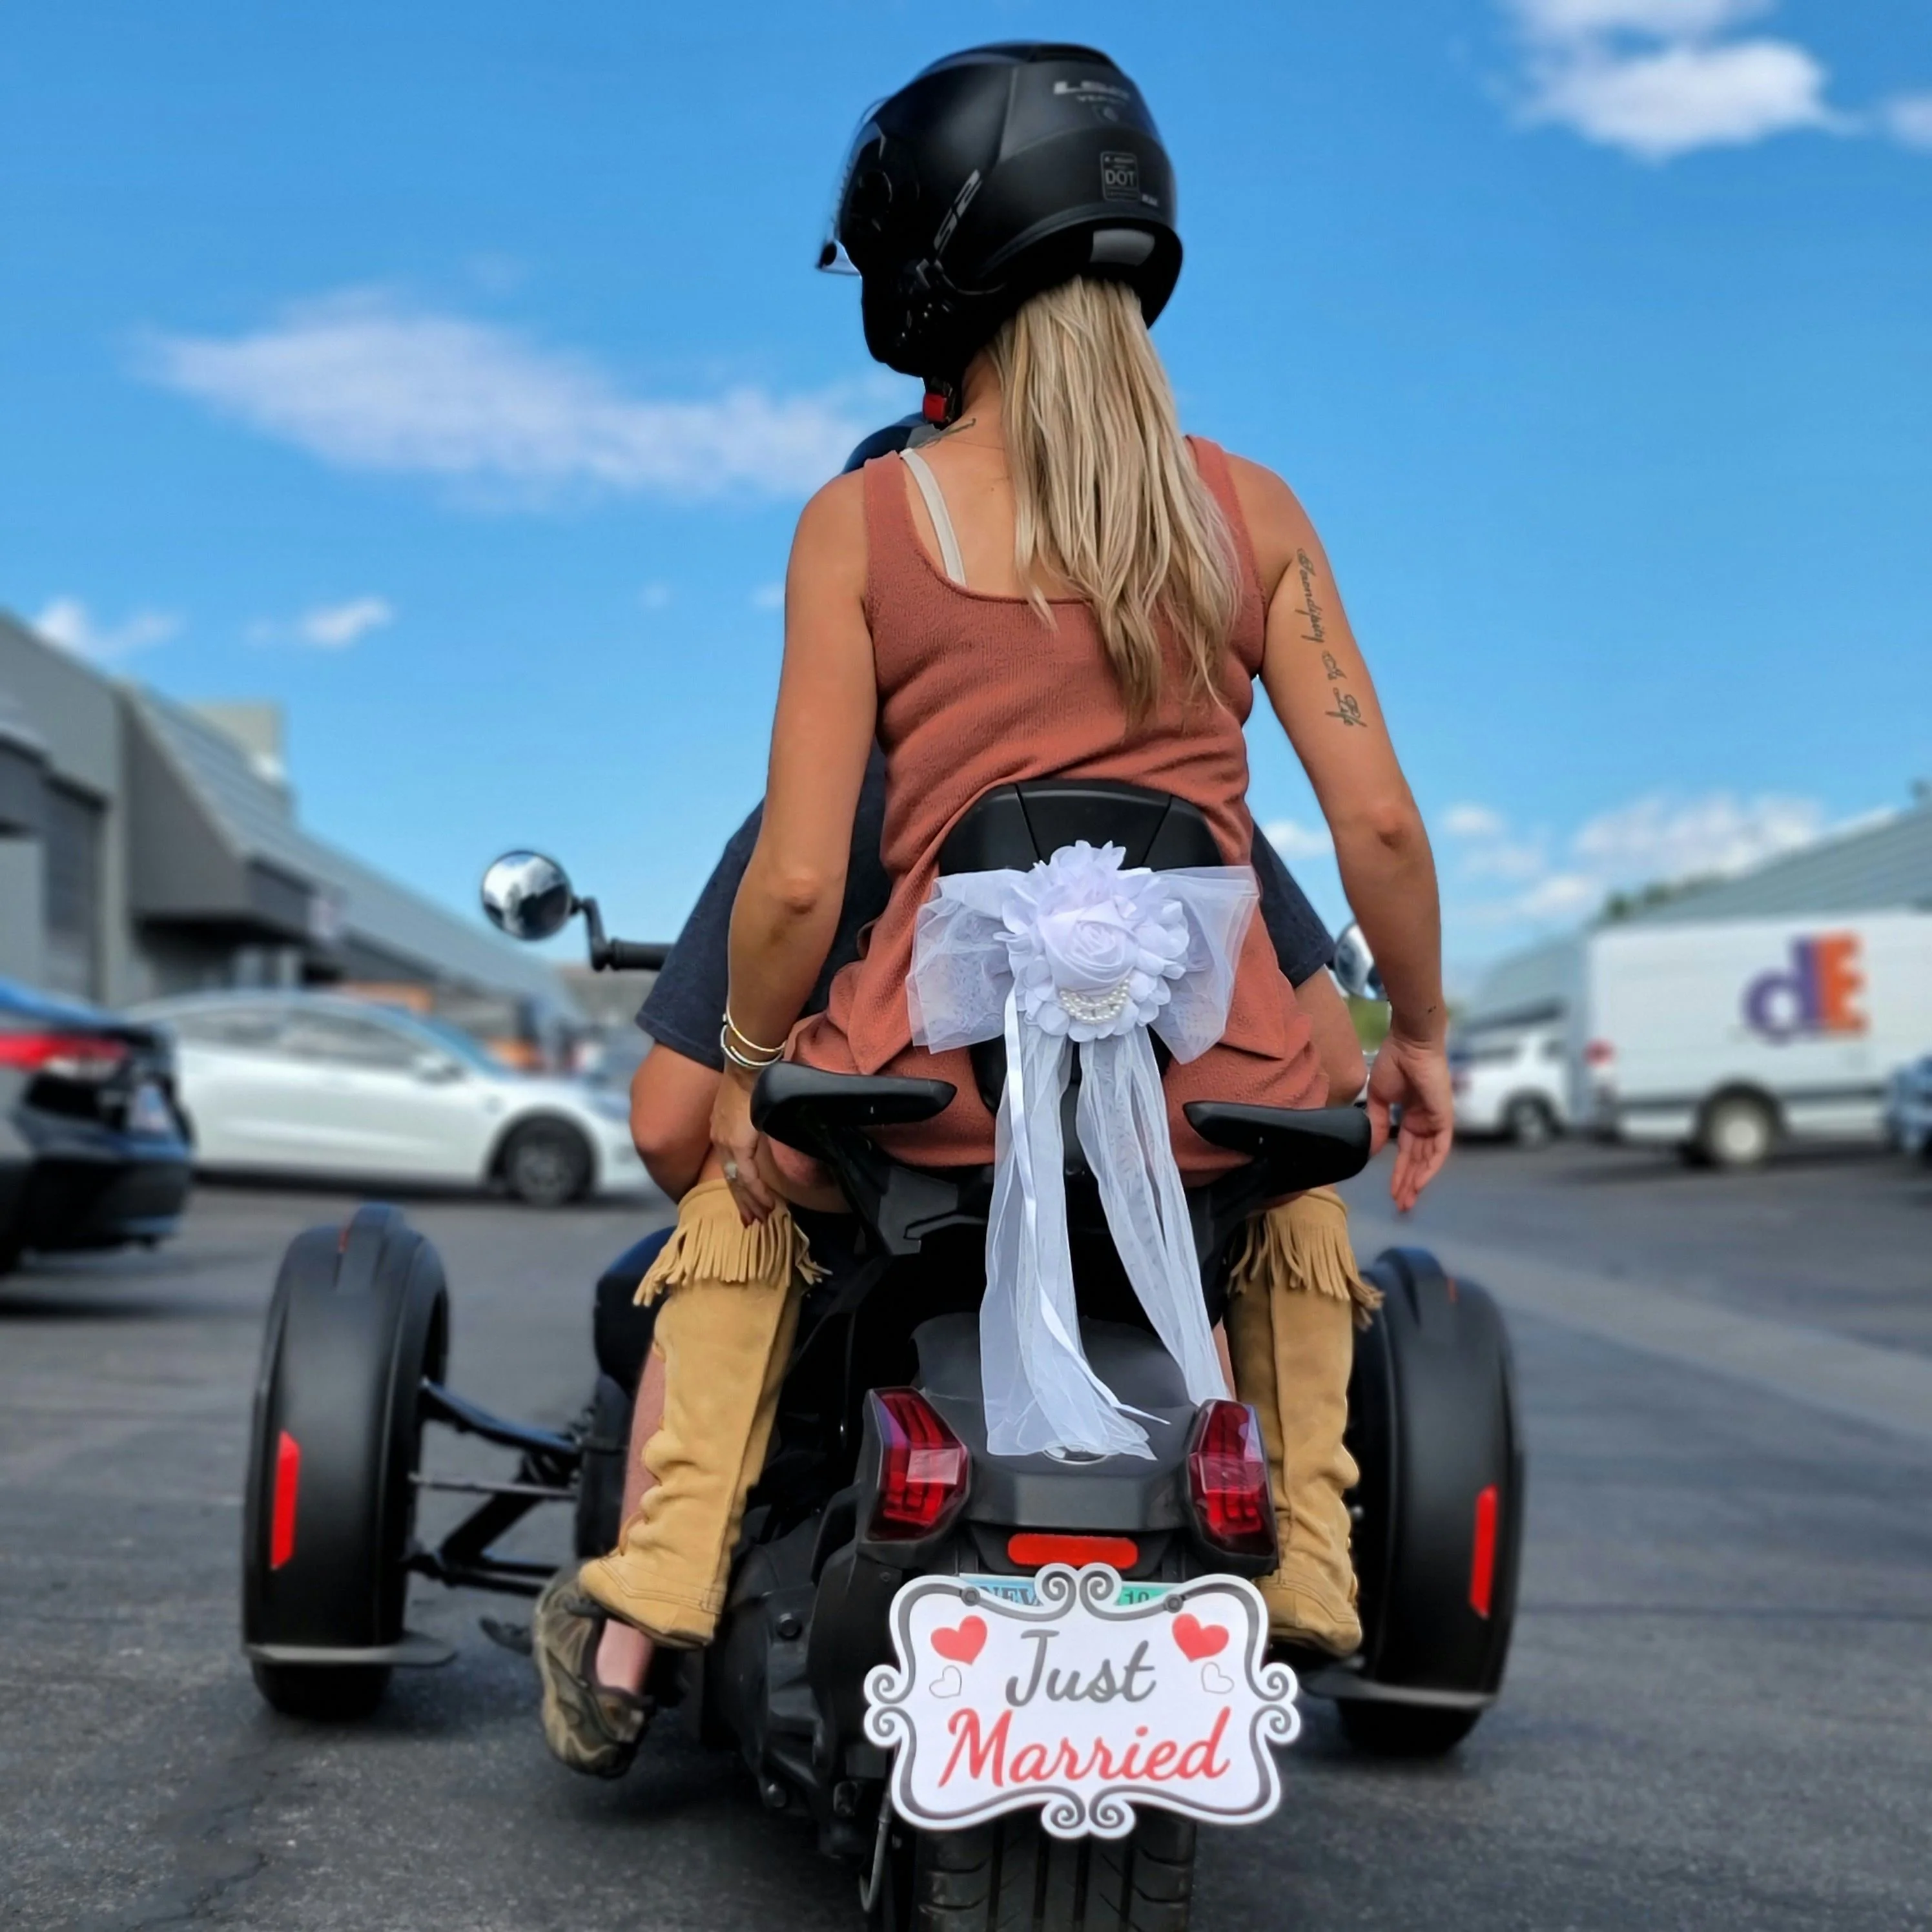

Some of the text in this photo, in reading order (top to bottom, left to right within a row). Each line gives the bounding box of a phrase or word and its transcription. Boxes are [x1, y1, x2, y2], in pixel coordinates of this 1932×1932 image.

[1105, 170, 1135, 186] DOT
[1005, 1629, 1156, 1707] Just
[938, 1706, 1231, 1788] Married
